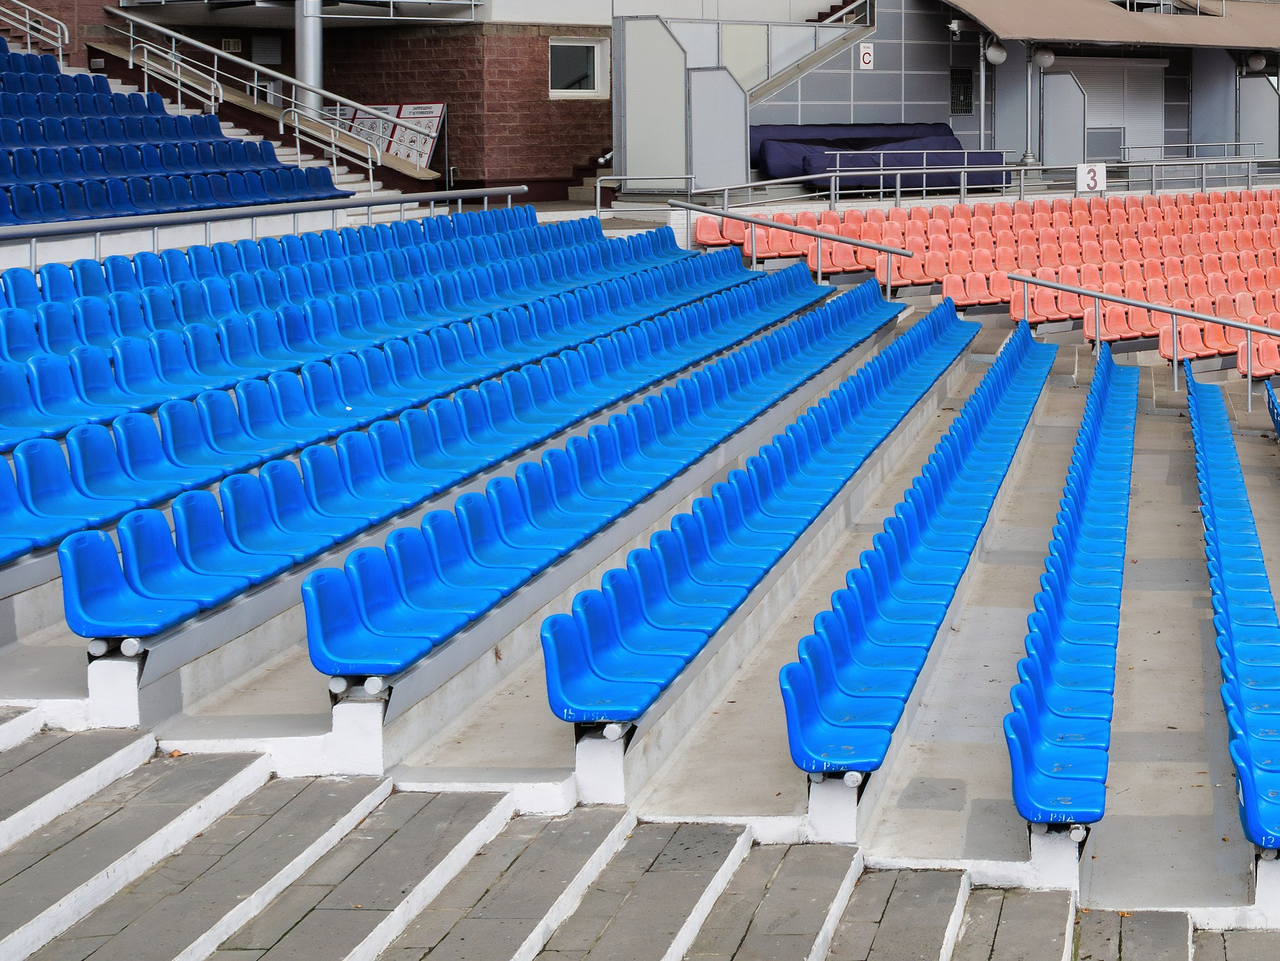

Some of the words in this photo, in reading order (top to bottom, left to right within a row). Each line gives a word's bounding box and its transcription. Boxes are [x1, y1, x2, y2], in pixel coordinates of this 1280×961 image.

[1086, 168, 1098, 191] 3
[563, 708, 576, 720] 15
[1261, 835, 1275, 848] 12
